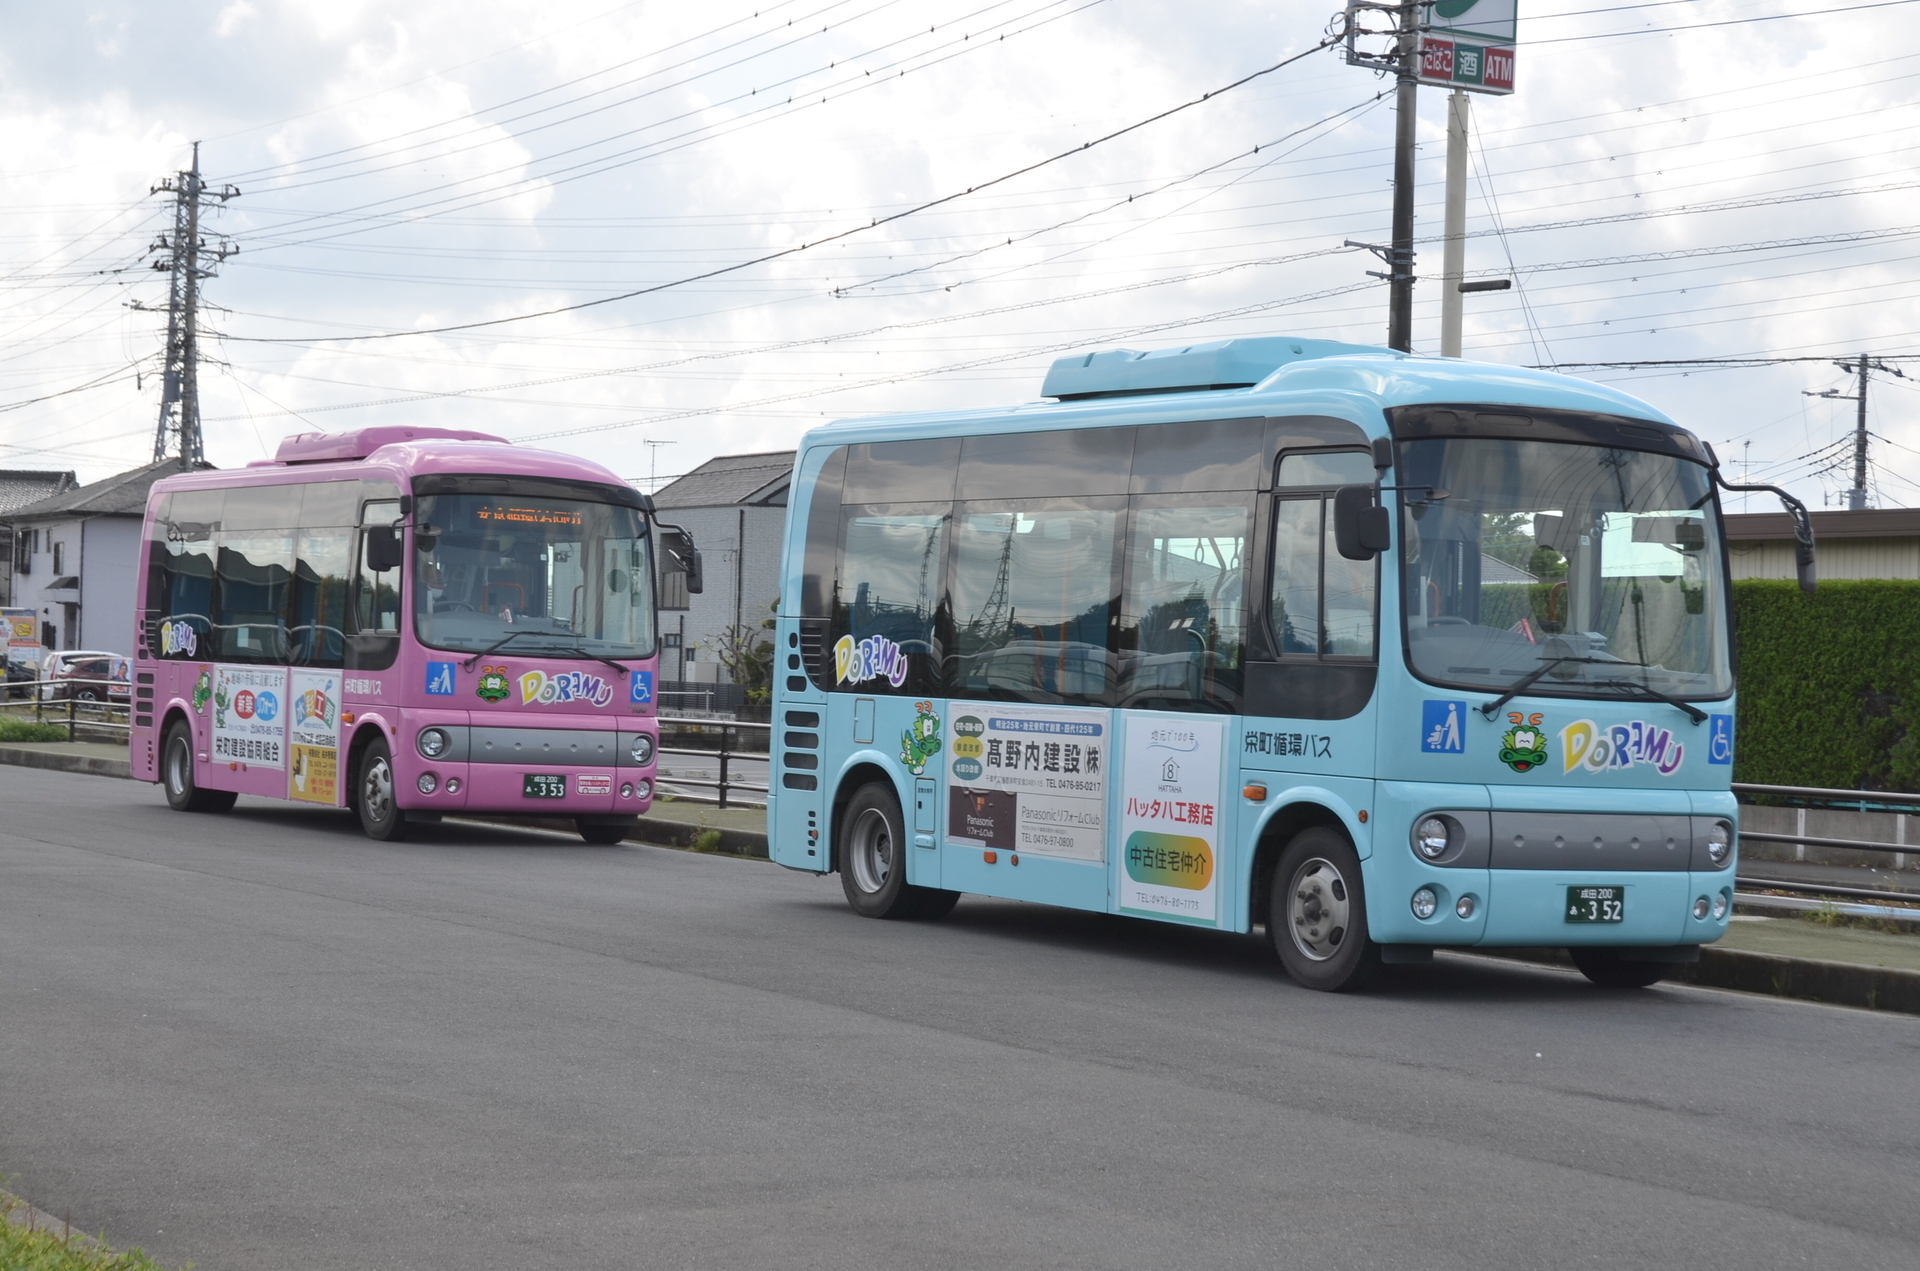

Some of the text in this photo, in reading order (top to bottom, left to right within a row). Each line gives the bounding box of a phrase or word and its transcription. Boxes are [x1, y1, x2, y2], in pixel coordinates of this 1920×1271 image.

[1423, 43, 1452, 73] たばこ
[1459, 50, 1478, 77] 酒
[1485, 55, 1513, 82] ATM
[1244, 730, 1332, 759] 栄町循環バス
[546, 775, 558, 783] 200
[1167, 763, 1174, 780] 8
[1046, 778, 1057, 789] TEL
[1058, 779, 1101, 792] 0476-95-0217
[1158, 784, 1182, 794] HATTAHA
[967, 814, 994, 828] Panasonic
[1021, 805, 1057, 822] Panasonic
[1021, 832, 1074, 848] TEL 0476-97-0800
[1129, 845, 1207, 876] 中古住宅仲介
[1580, 888, 1613, 899] 成田 200
[1569, 905, 1578, 915] あ
